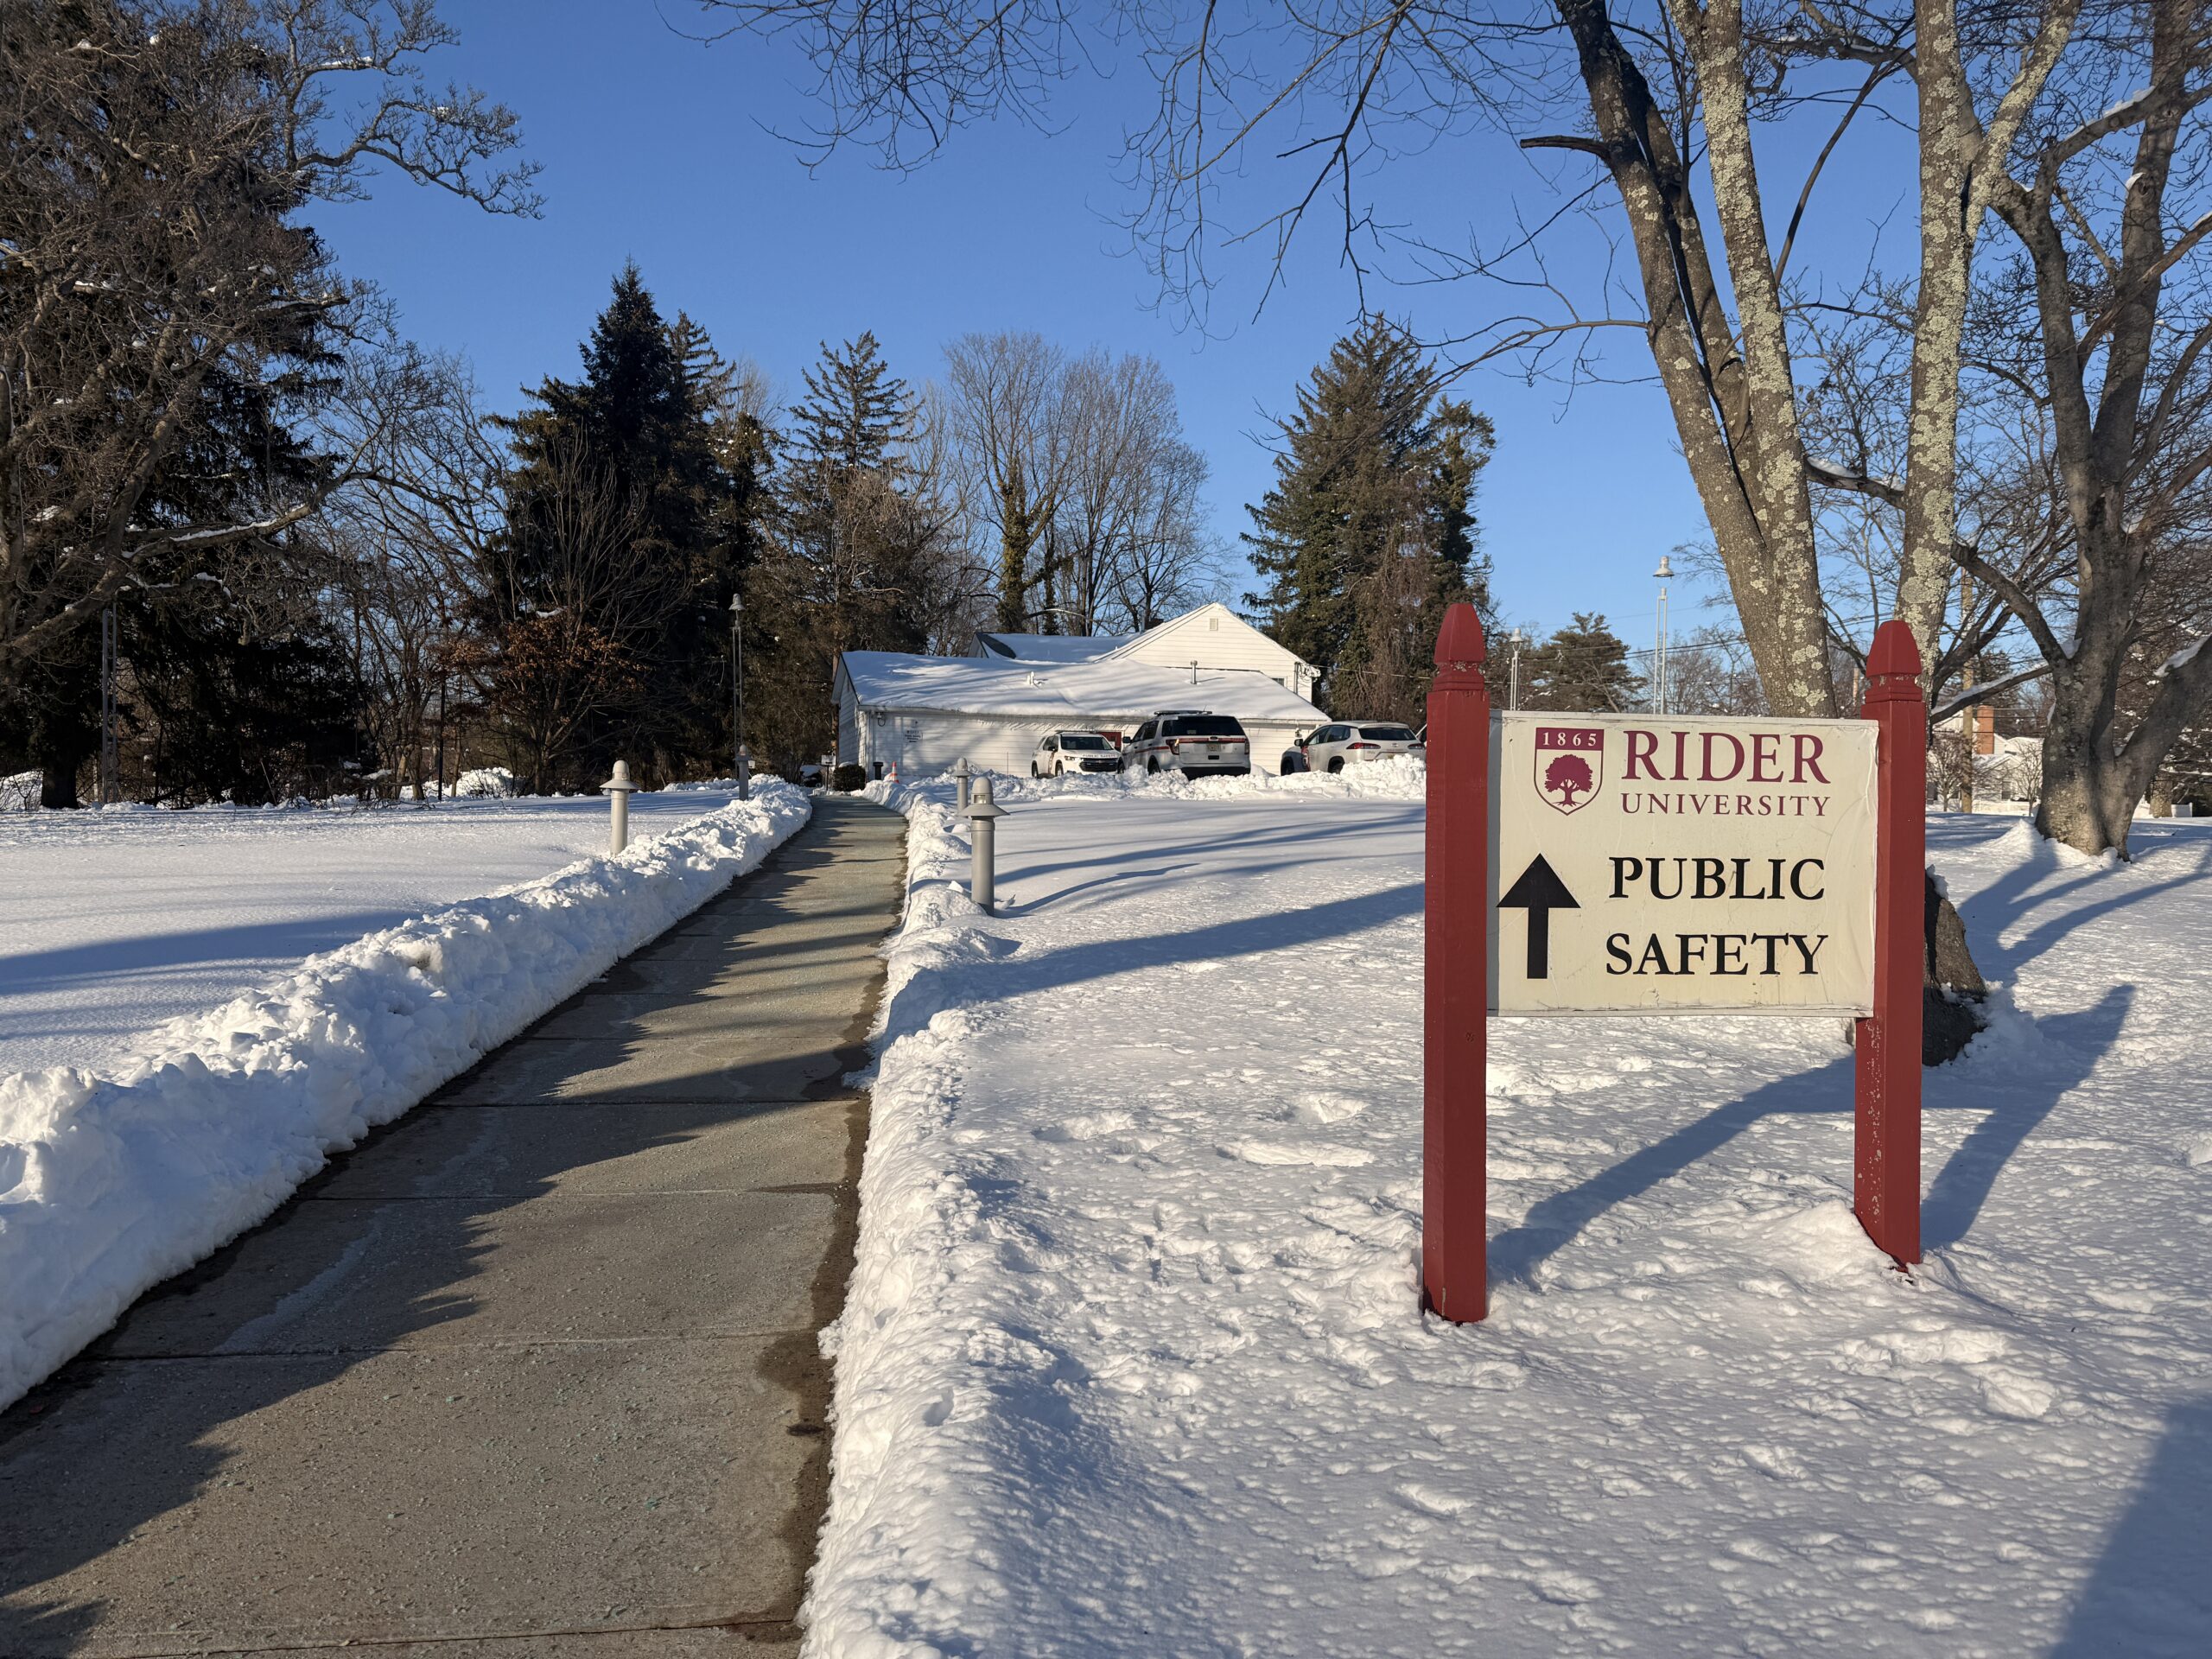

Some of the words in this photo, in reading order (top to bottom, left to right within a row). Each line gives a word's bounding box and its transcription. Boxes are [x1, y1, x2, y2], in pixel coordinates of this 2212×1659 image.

[1542, 732, 1597, 747] 1865
[1621, 730, 1831, 785] RIDER
[1621, 792, 1830, 817] UNIVERSITY
[1608, 856, 1825, 900] PUBLIC
[1605, 932, 1829, 976] SAFETY
